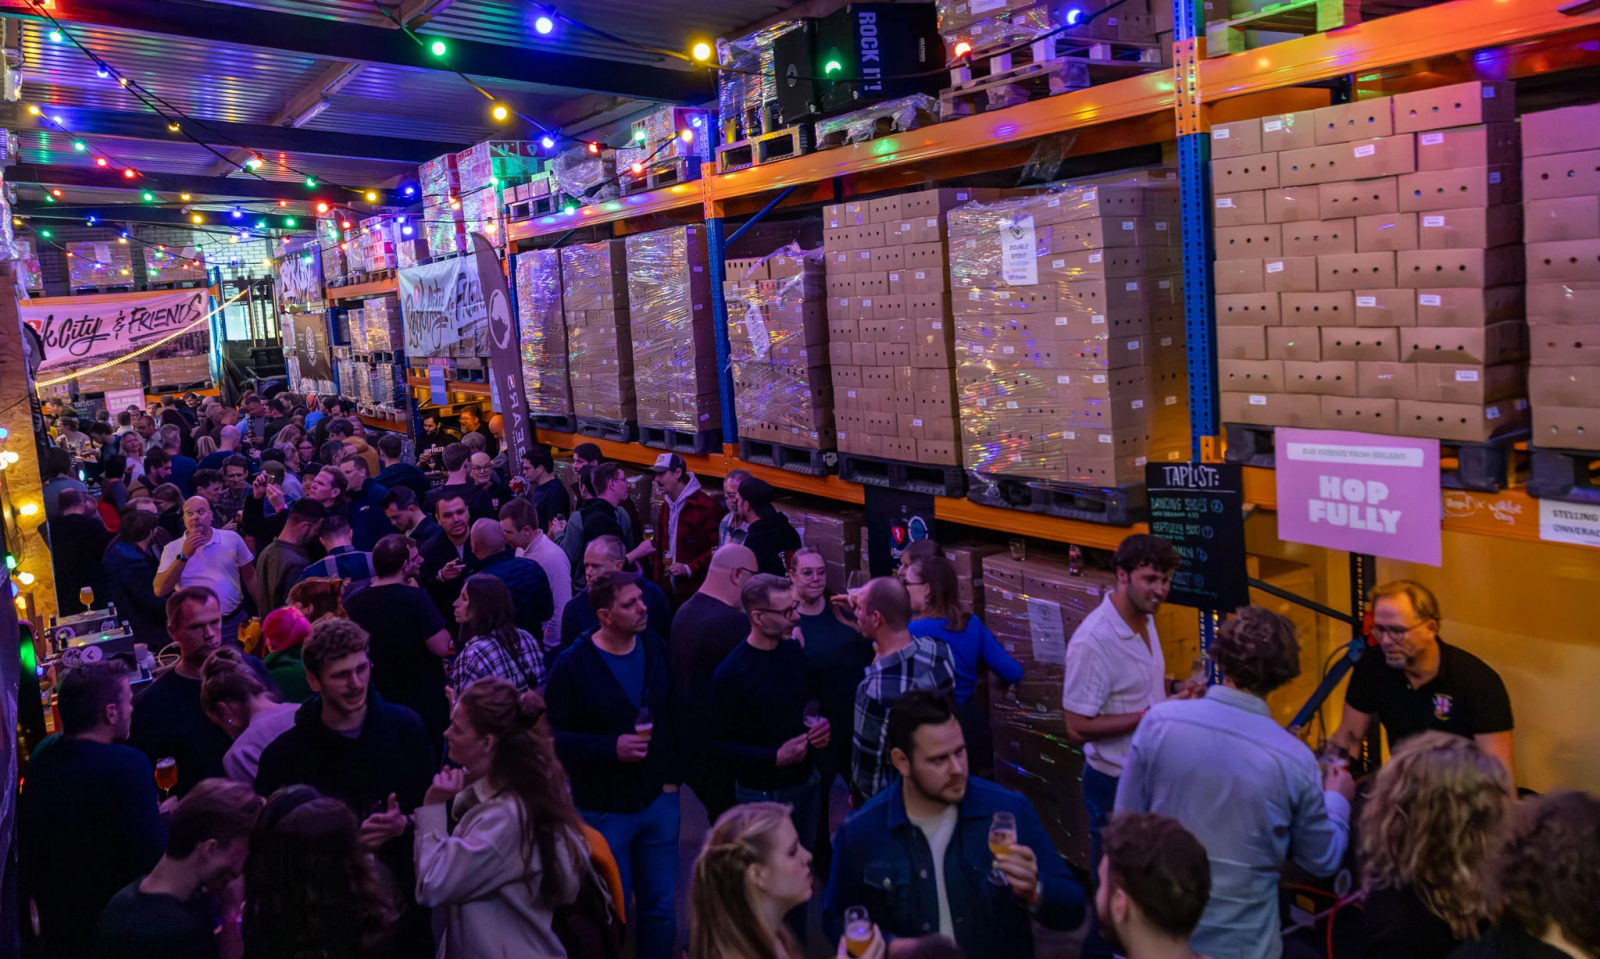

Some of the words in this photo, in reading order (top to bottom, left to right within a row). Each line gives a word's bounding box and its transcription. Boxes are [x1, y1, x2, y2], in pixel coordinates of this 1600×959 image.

[859, 12, 879, 62] ROCK
[58, 315, 111, 356] City
[113, 311, 125, 340] &
[129, 293, 202, 335] FRIENDS
[1162, 461, 1219, 487] TAPLIST:
[1319, 475, 1389, 505] HOP
[1308, 499, 1402, 534] FULLY
[1553, 509, 1599, 522] STELLING
